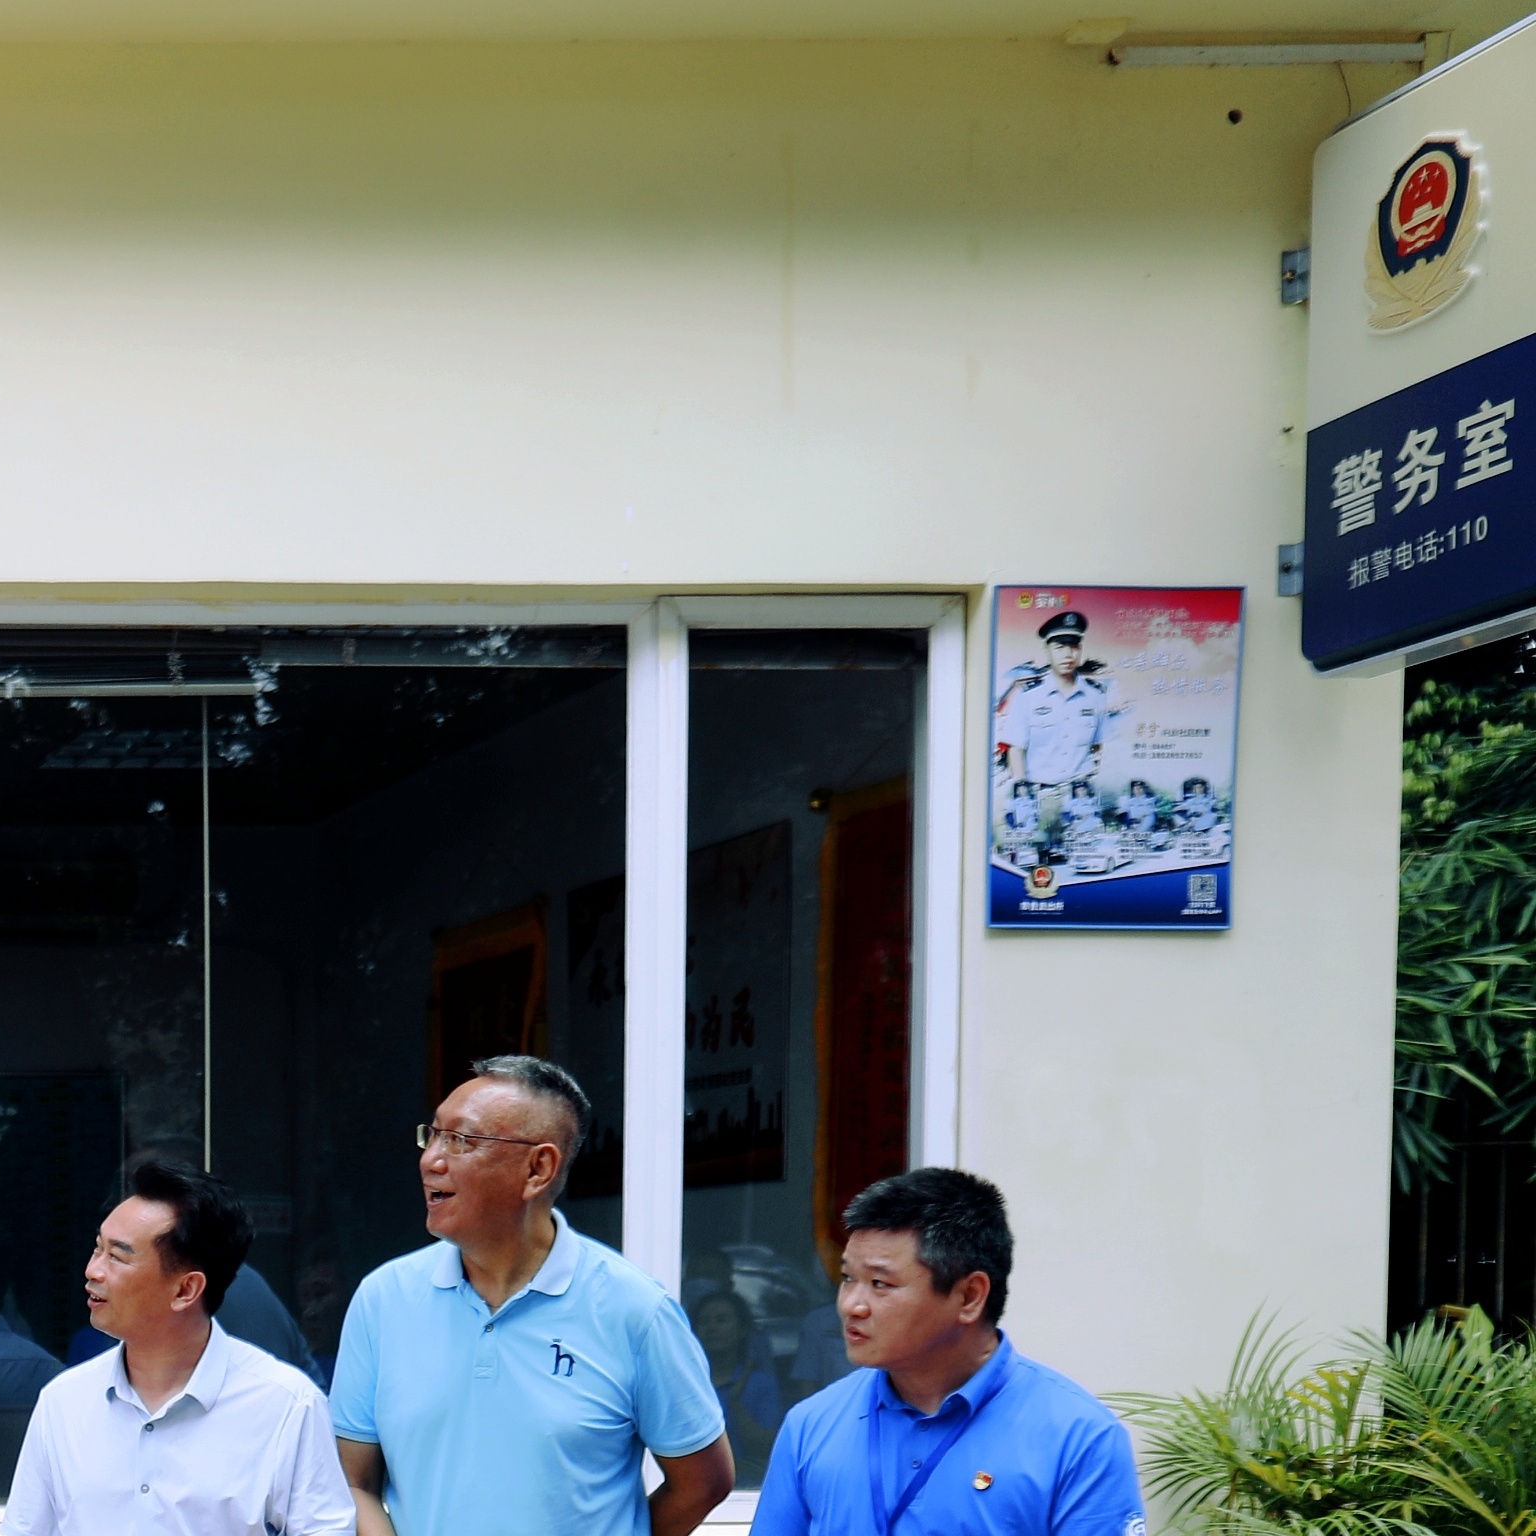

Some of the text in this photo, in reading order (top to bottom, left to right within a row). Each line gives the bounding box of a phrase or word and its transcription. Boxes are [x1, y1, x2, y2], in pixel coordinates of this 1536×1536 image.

[1330, 398, 1515, 537] 警务室
[1348, 515, 1489, 590] 报警电话:110
